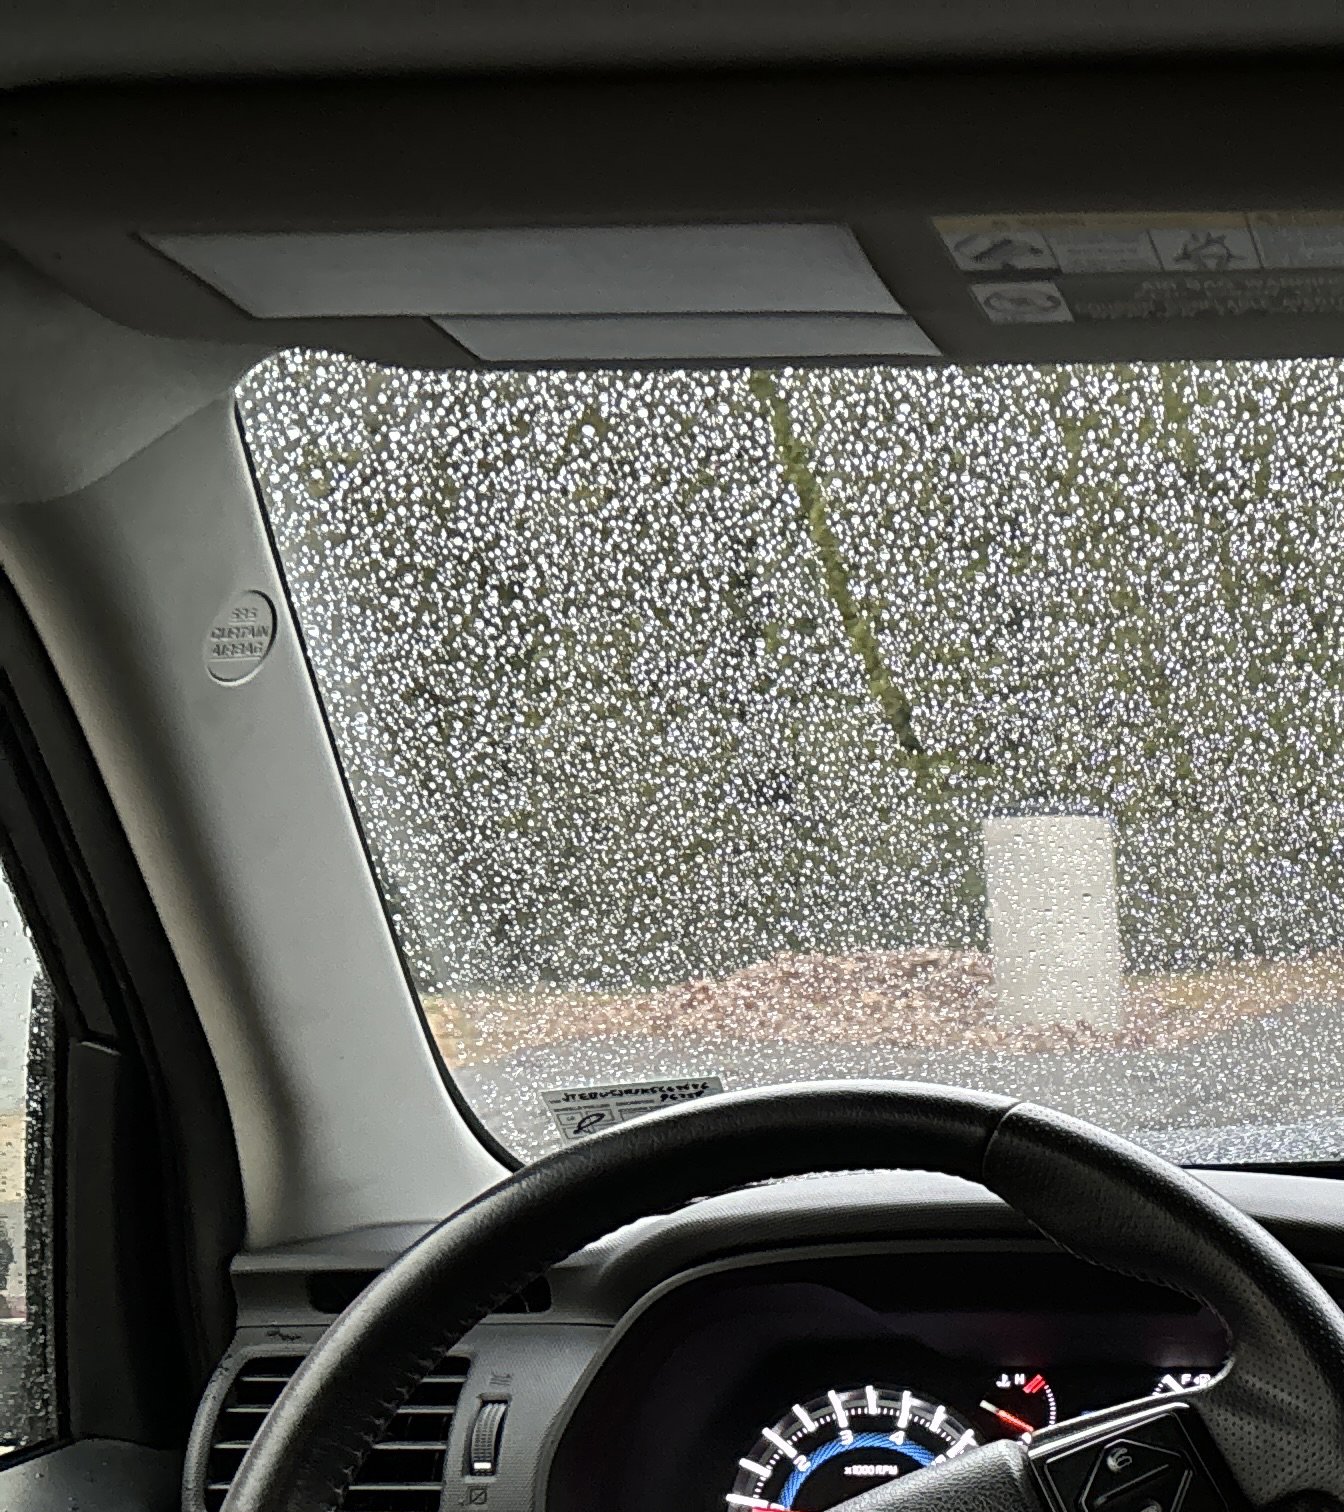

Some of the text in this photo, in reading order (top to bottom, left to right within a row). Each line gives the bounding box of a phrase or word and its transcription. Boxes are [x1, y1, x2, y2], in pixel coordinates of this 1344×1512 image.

[839, 1430, 854, 1445] 3
[889, 1430, 905, 1445] 4
[876, 1465, 898, 1476] RPM
